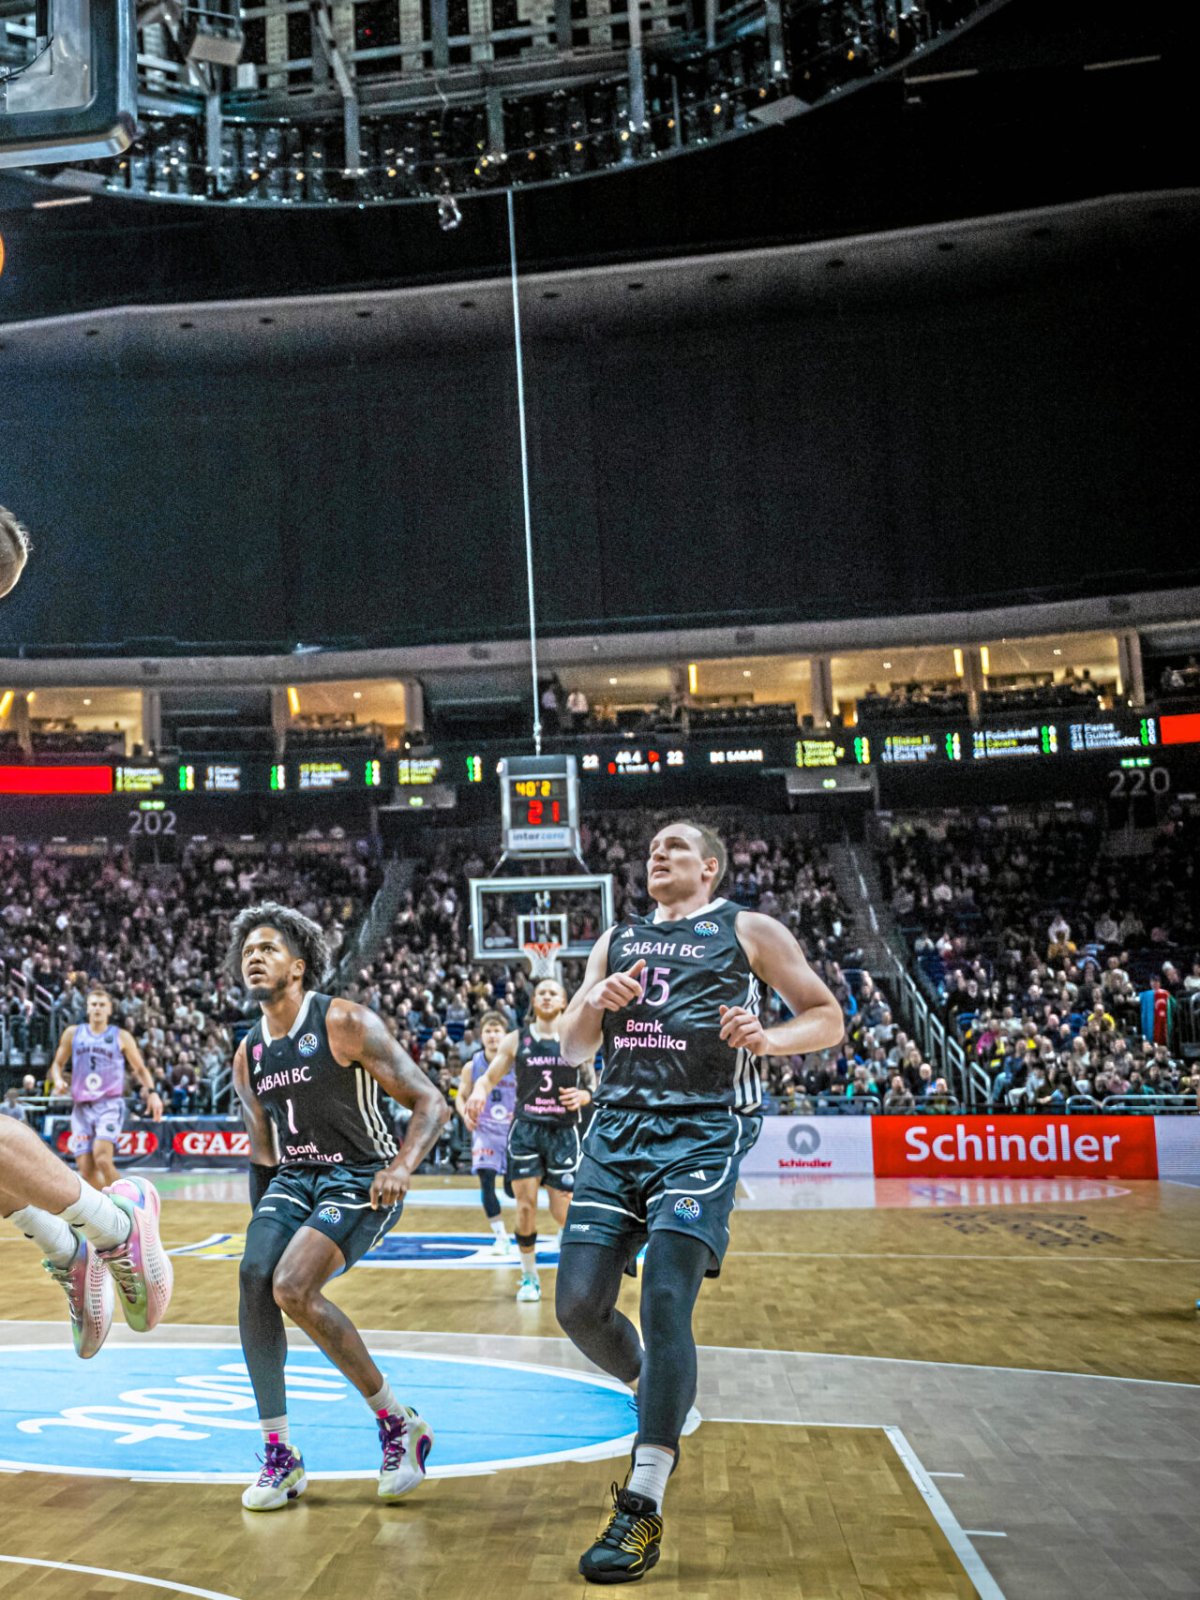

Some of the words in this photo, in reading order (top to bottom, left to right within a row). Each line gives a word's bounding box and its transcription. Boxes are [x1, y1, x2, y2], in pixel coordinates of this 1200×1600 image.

[1108, 767, 1170, 798] 220
[128, 811, 177, 835] 202
[621, 941, 676, 958] SABAH
[680, 944, 706, 959] BC
[636, 966, 672, 1006] 15
[626, 1019, 663, 1034] Bank
[527, 1056, 556, 1066] SABAH
[257, 1070, 290, 1095] SABAH
[292, 1066, 312, 1082] BC
[540, 1070, 553, 1092] 3
[286, 1099, 299, 1134] 1
[182, 1132, 250, 1155] GAZ
[286, 1141, 319, 1156] Bank
[905, 1124, 1121, 1163] Schindler
[778, 1158, 832, 1169] Schindler
